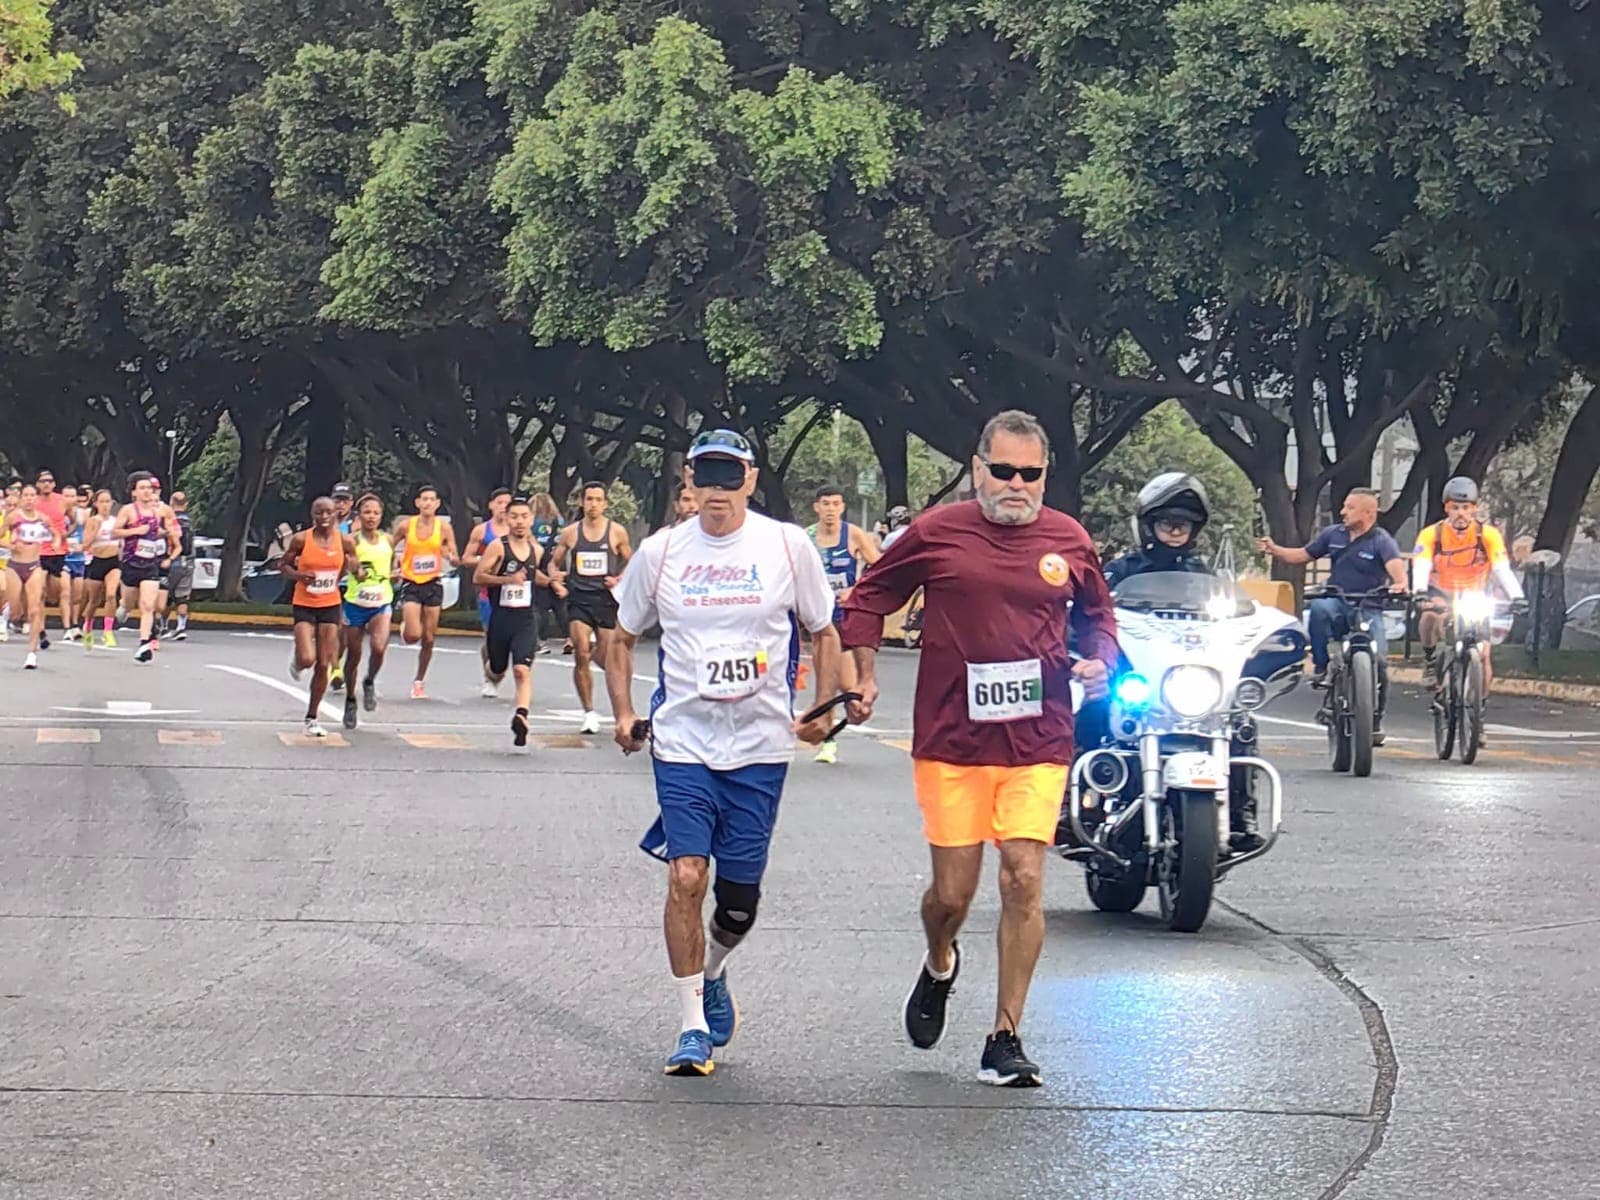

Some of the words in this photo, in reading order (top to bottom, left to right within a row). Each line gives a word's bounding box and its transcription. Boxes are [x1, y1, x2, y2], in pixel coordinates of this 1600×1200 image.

[683, 597, 697, 606] de
[701, 595, 761, 606] Ensenada
[706, 656, 760, 685] 2451
[975, 680, 1034, 706] 6055
